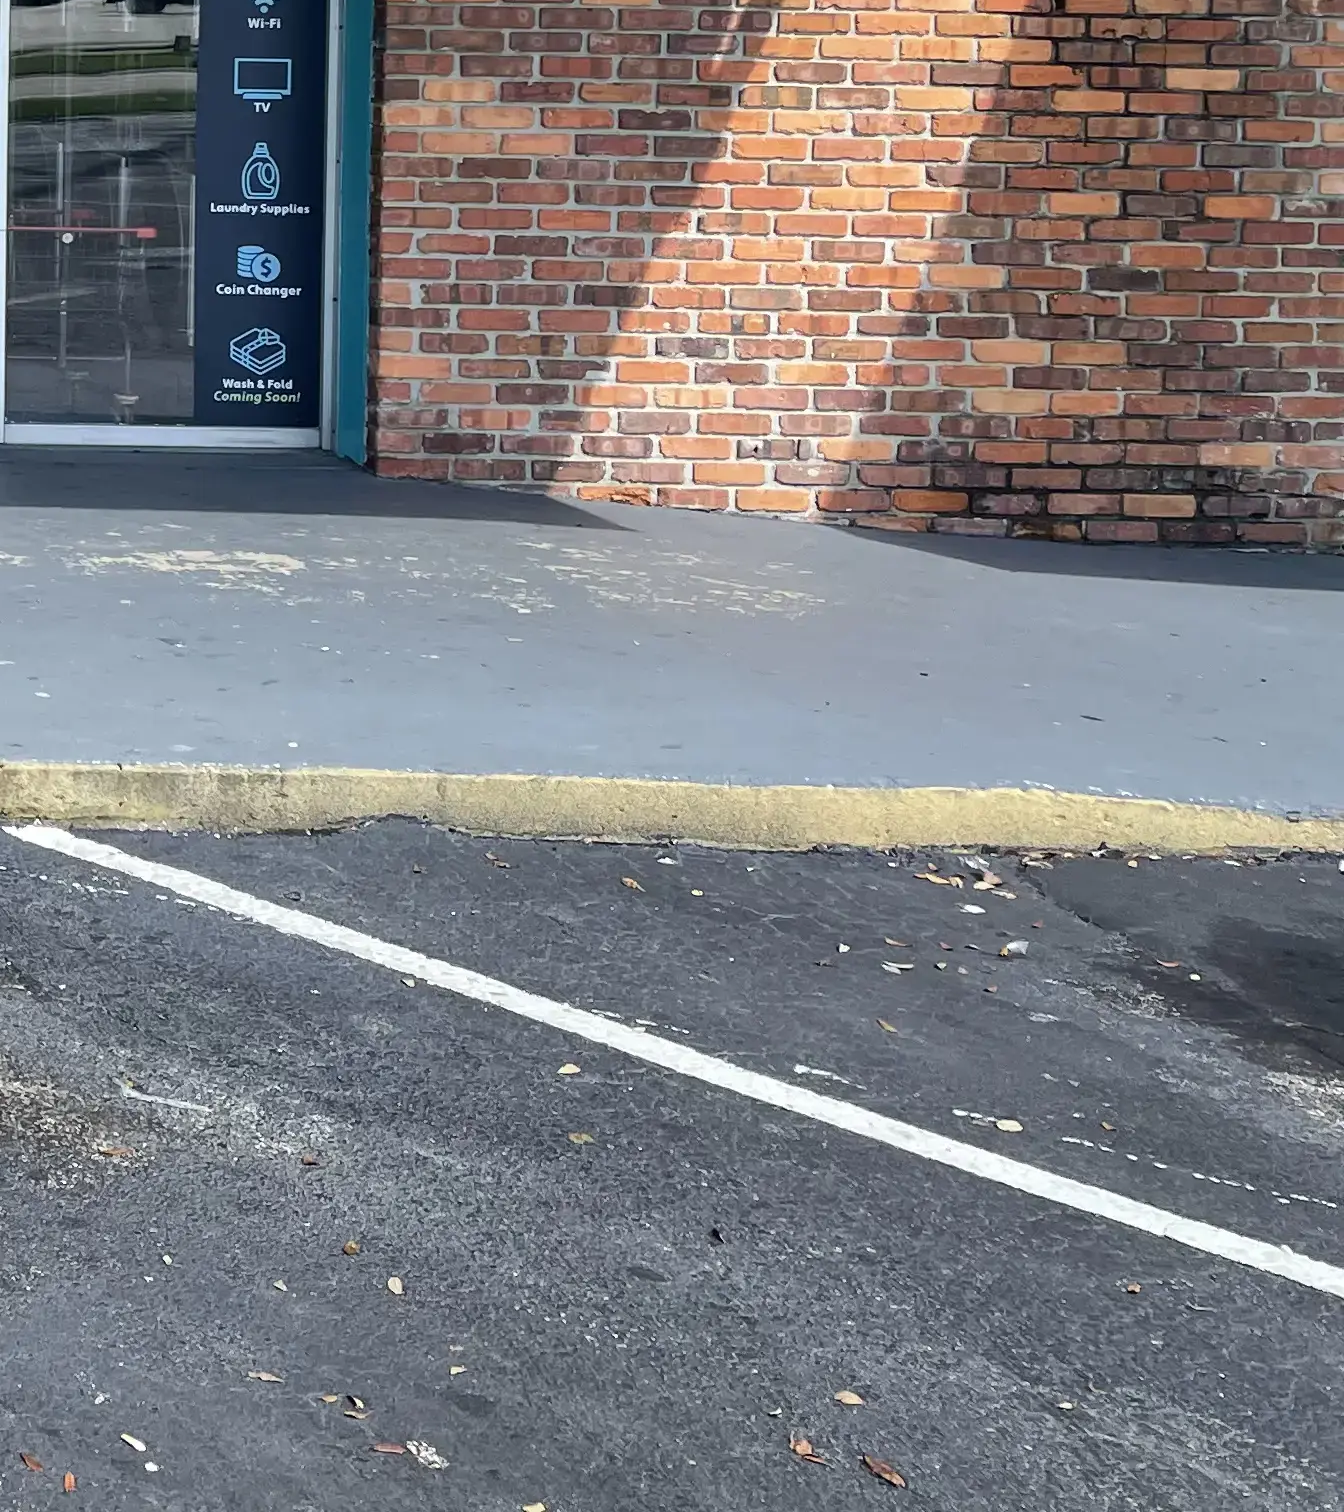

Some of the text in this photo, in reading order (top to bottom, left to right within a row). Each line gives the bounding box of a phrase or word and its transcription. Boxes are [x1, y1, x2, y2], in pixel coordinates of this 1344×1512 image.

[247, 17, 282, 29] Wi-Fi
[253, 101, 272, 113] TV
[210, 202, 310, 217] Laundry Supplies
[215, 283, 302, 299] Coin Changer
[222, 378, 294, 390] Wash & Fold
[213, 390, 301, 404] Coming Soon!
